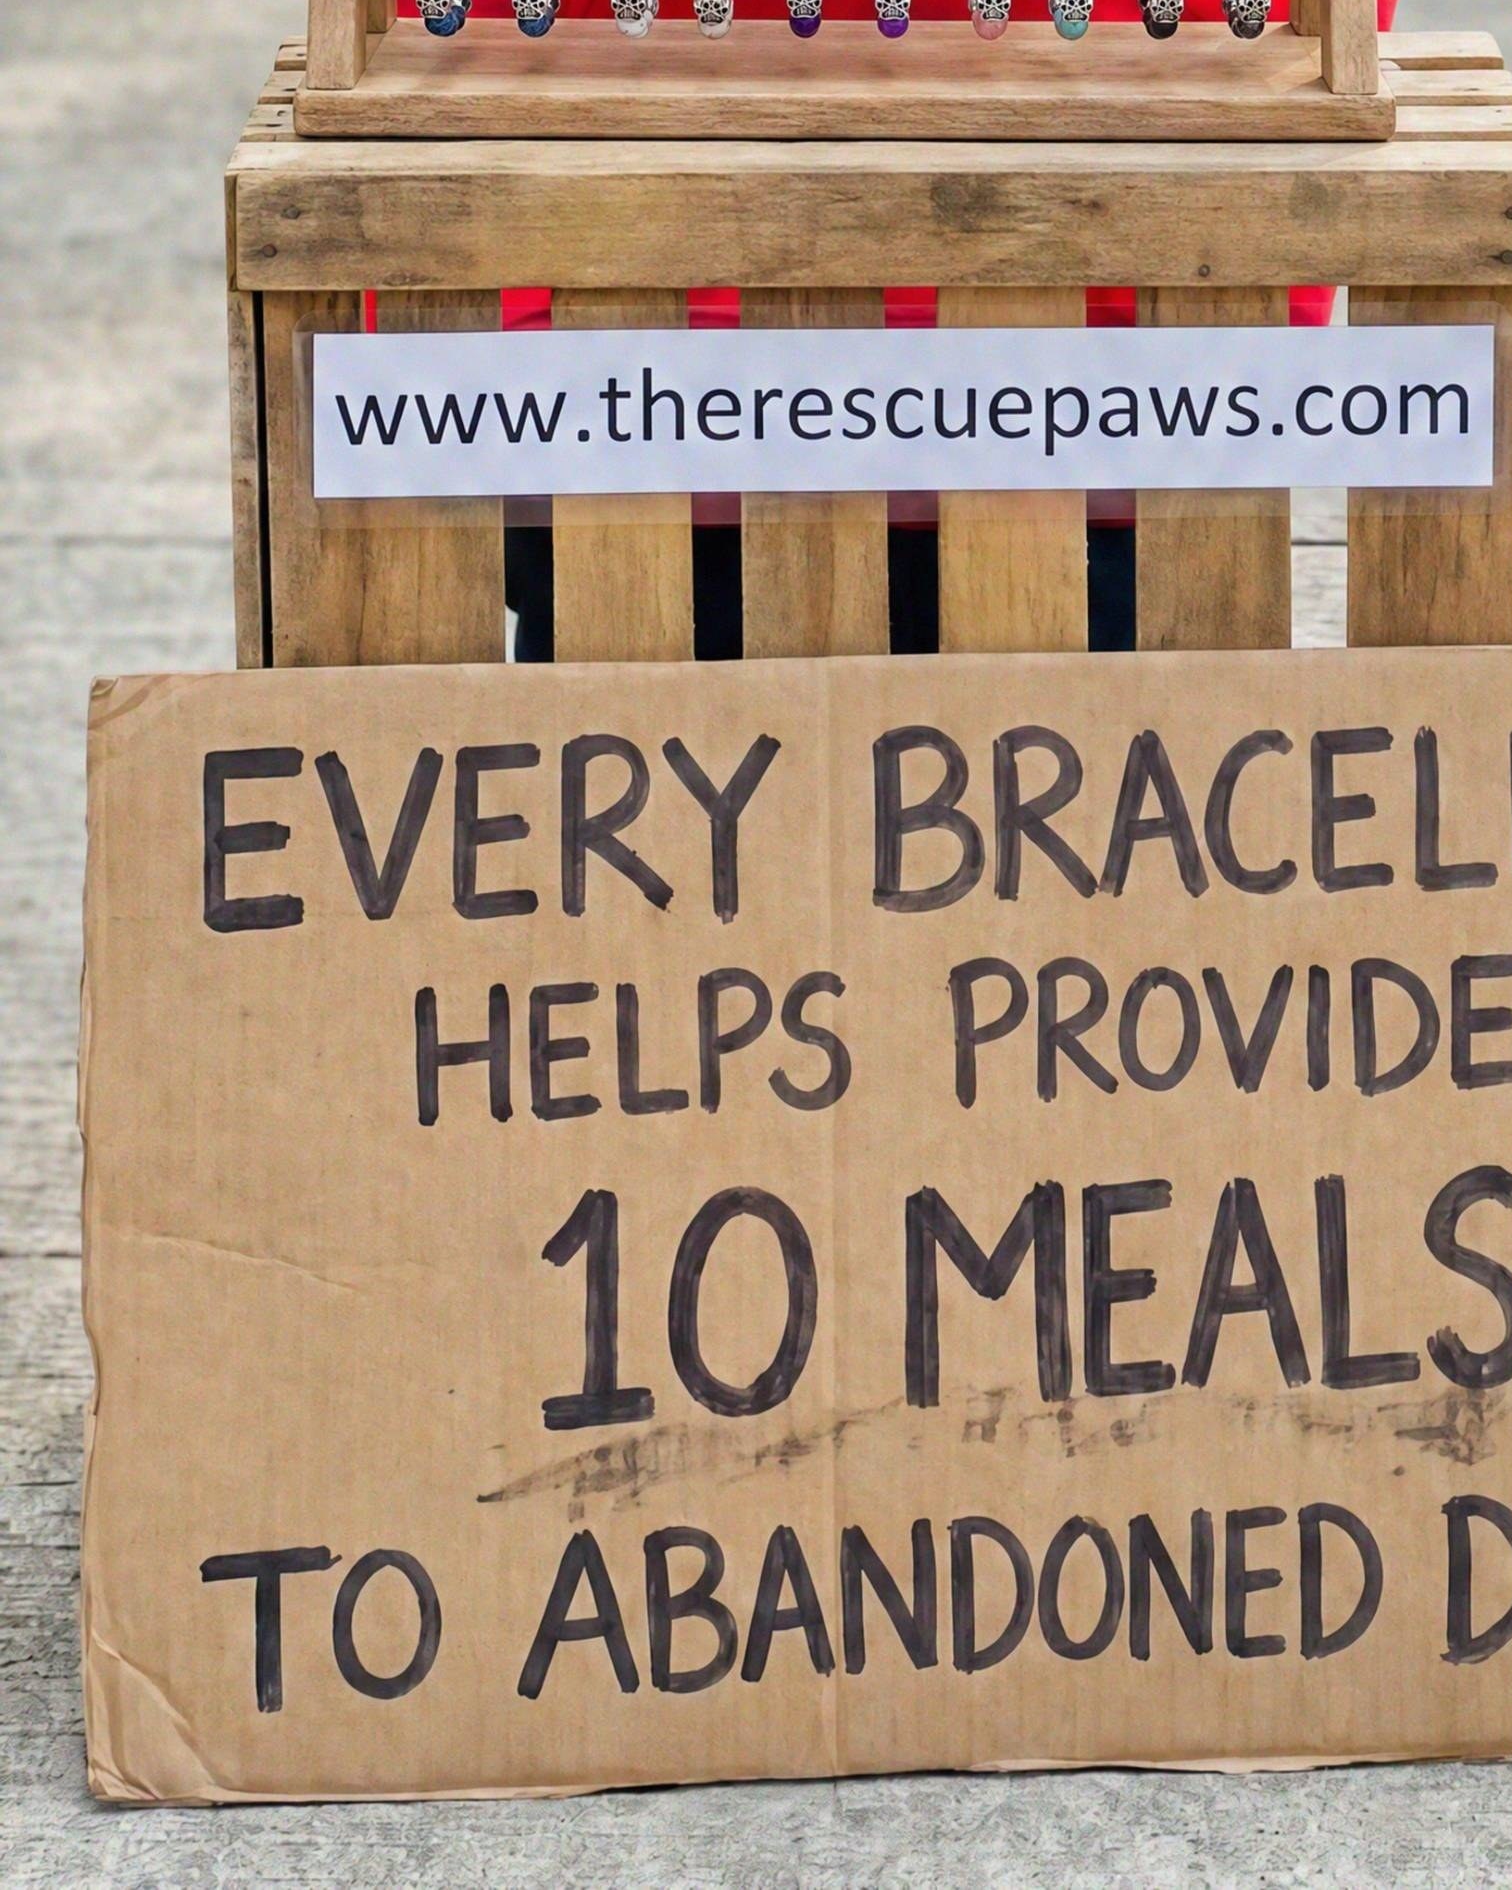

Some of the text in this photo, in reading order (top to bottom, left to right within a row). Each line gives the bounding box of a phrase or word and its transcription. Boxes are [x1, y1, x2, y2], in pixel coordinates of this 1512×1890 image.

[334, 366, 1471, 458] www.therescuepaws.com
[202, 732, 784, 935] EVERY
[413, 966, 853, 1128] HELPS
[540, 1184, 819, 1432] 10
[198, 1544, 443, 1715] TO
[516, 1499, 1386, 1702] ABANDONED
